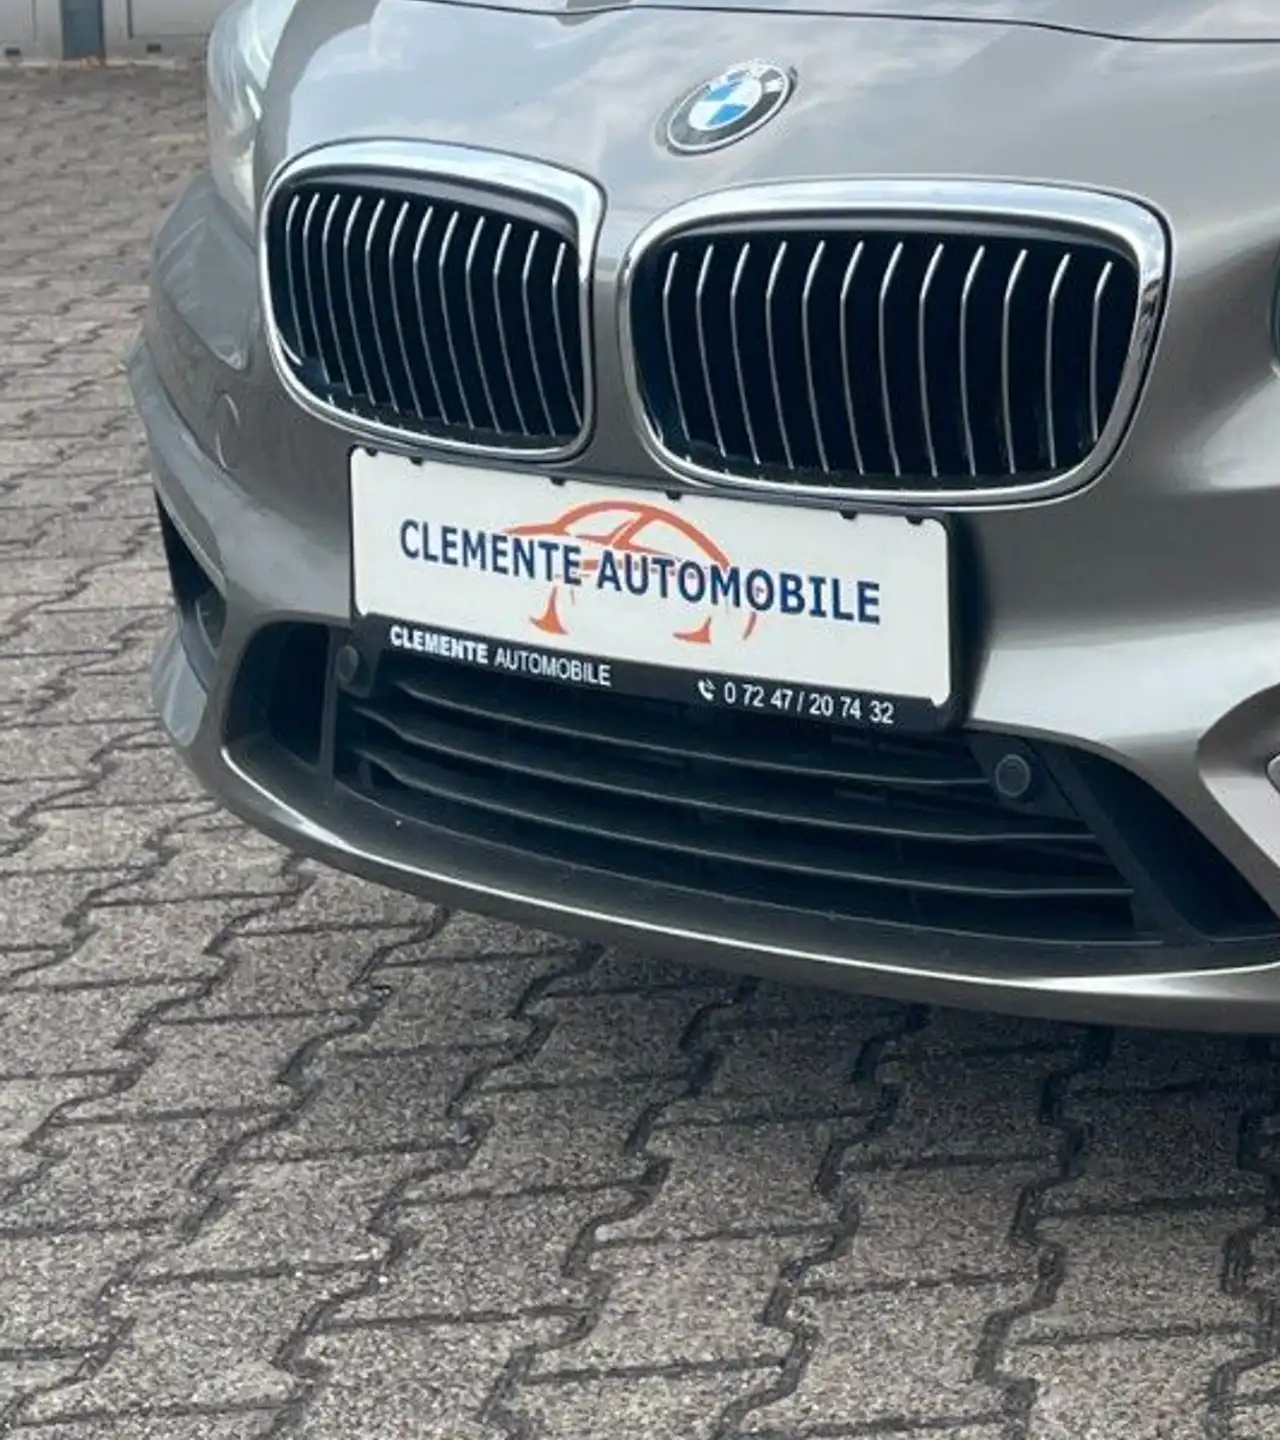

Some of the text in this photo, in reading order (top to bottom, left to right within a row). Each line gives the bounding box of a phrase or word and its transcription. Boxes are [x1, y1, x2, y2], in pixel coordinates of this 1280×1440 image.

[400, 519, 881, 625] CLEMENTE AUTOMOBILE
[390, 625, 612, 686] CLEMENTE AUTOMOBILE
[724, 681, 736, 704] 0
[742, 684, 765, 707] 72
[770, 688, 794, 710] 47
[809, 693, 834, 717] 20
[840, 696, 862, 720] 74
[869, 700, 894, 724] 32
